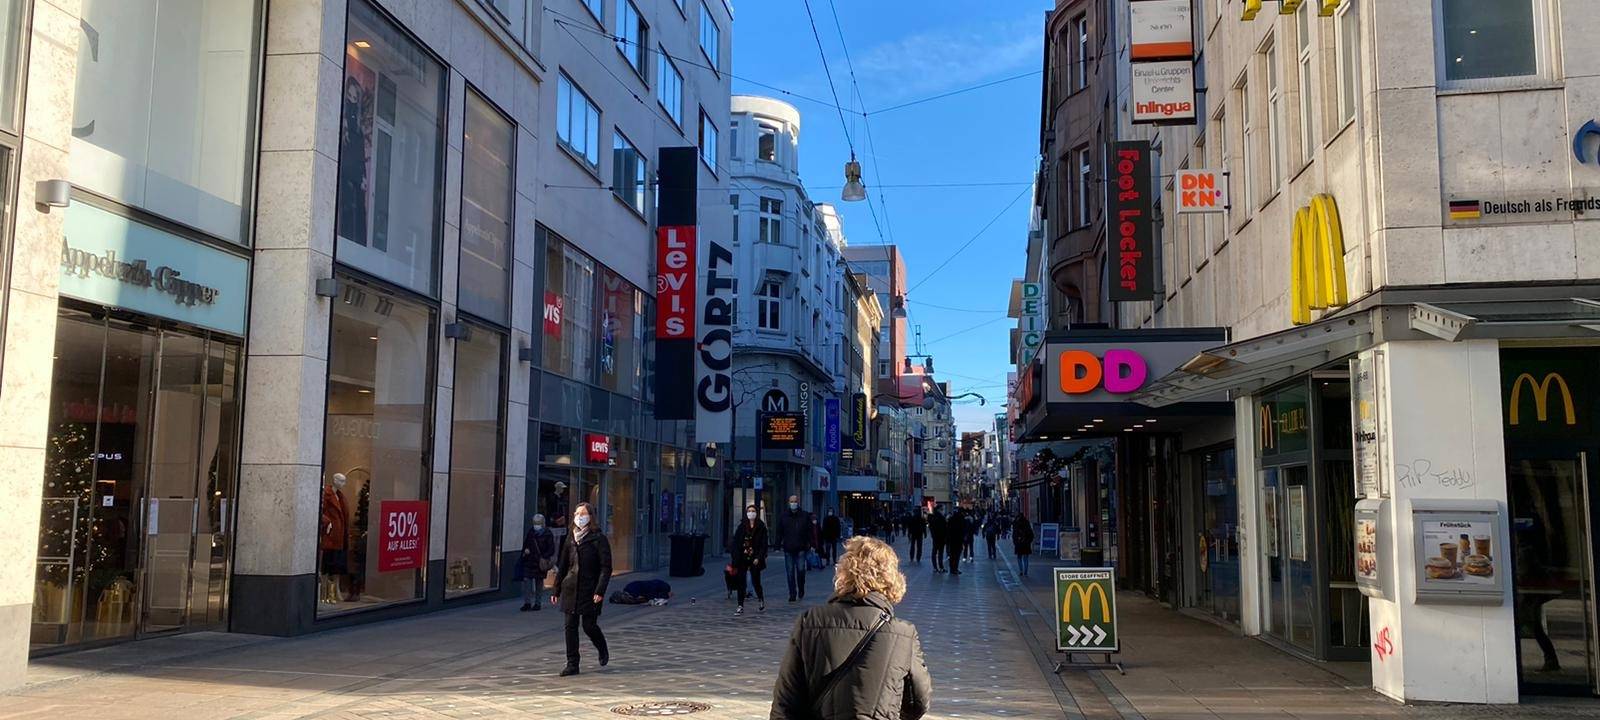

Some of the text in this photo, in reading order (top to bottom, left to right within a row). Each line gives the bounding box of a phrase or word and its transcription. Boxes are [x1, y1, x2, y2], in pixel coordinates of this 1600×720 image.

[1151, 85, 1175, 93] Center
[1181, 174, 1214, 189] DN
[1182, 191, 1215, 207] KN
[1484, 199, 1530, 214] Deutsch
[1534, 199, 1552, 212] als
[1117, 149, 1142, 291] Foot Locker
[1059, 349, 1147, 394] DD
[828, 423, 837, 449] Apollo
[388, 511, 418, 538] 50%
[387, 540, 400, 551] AUF
